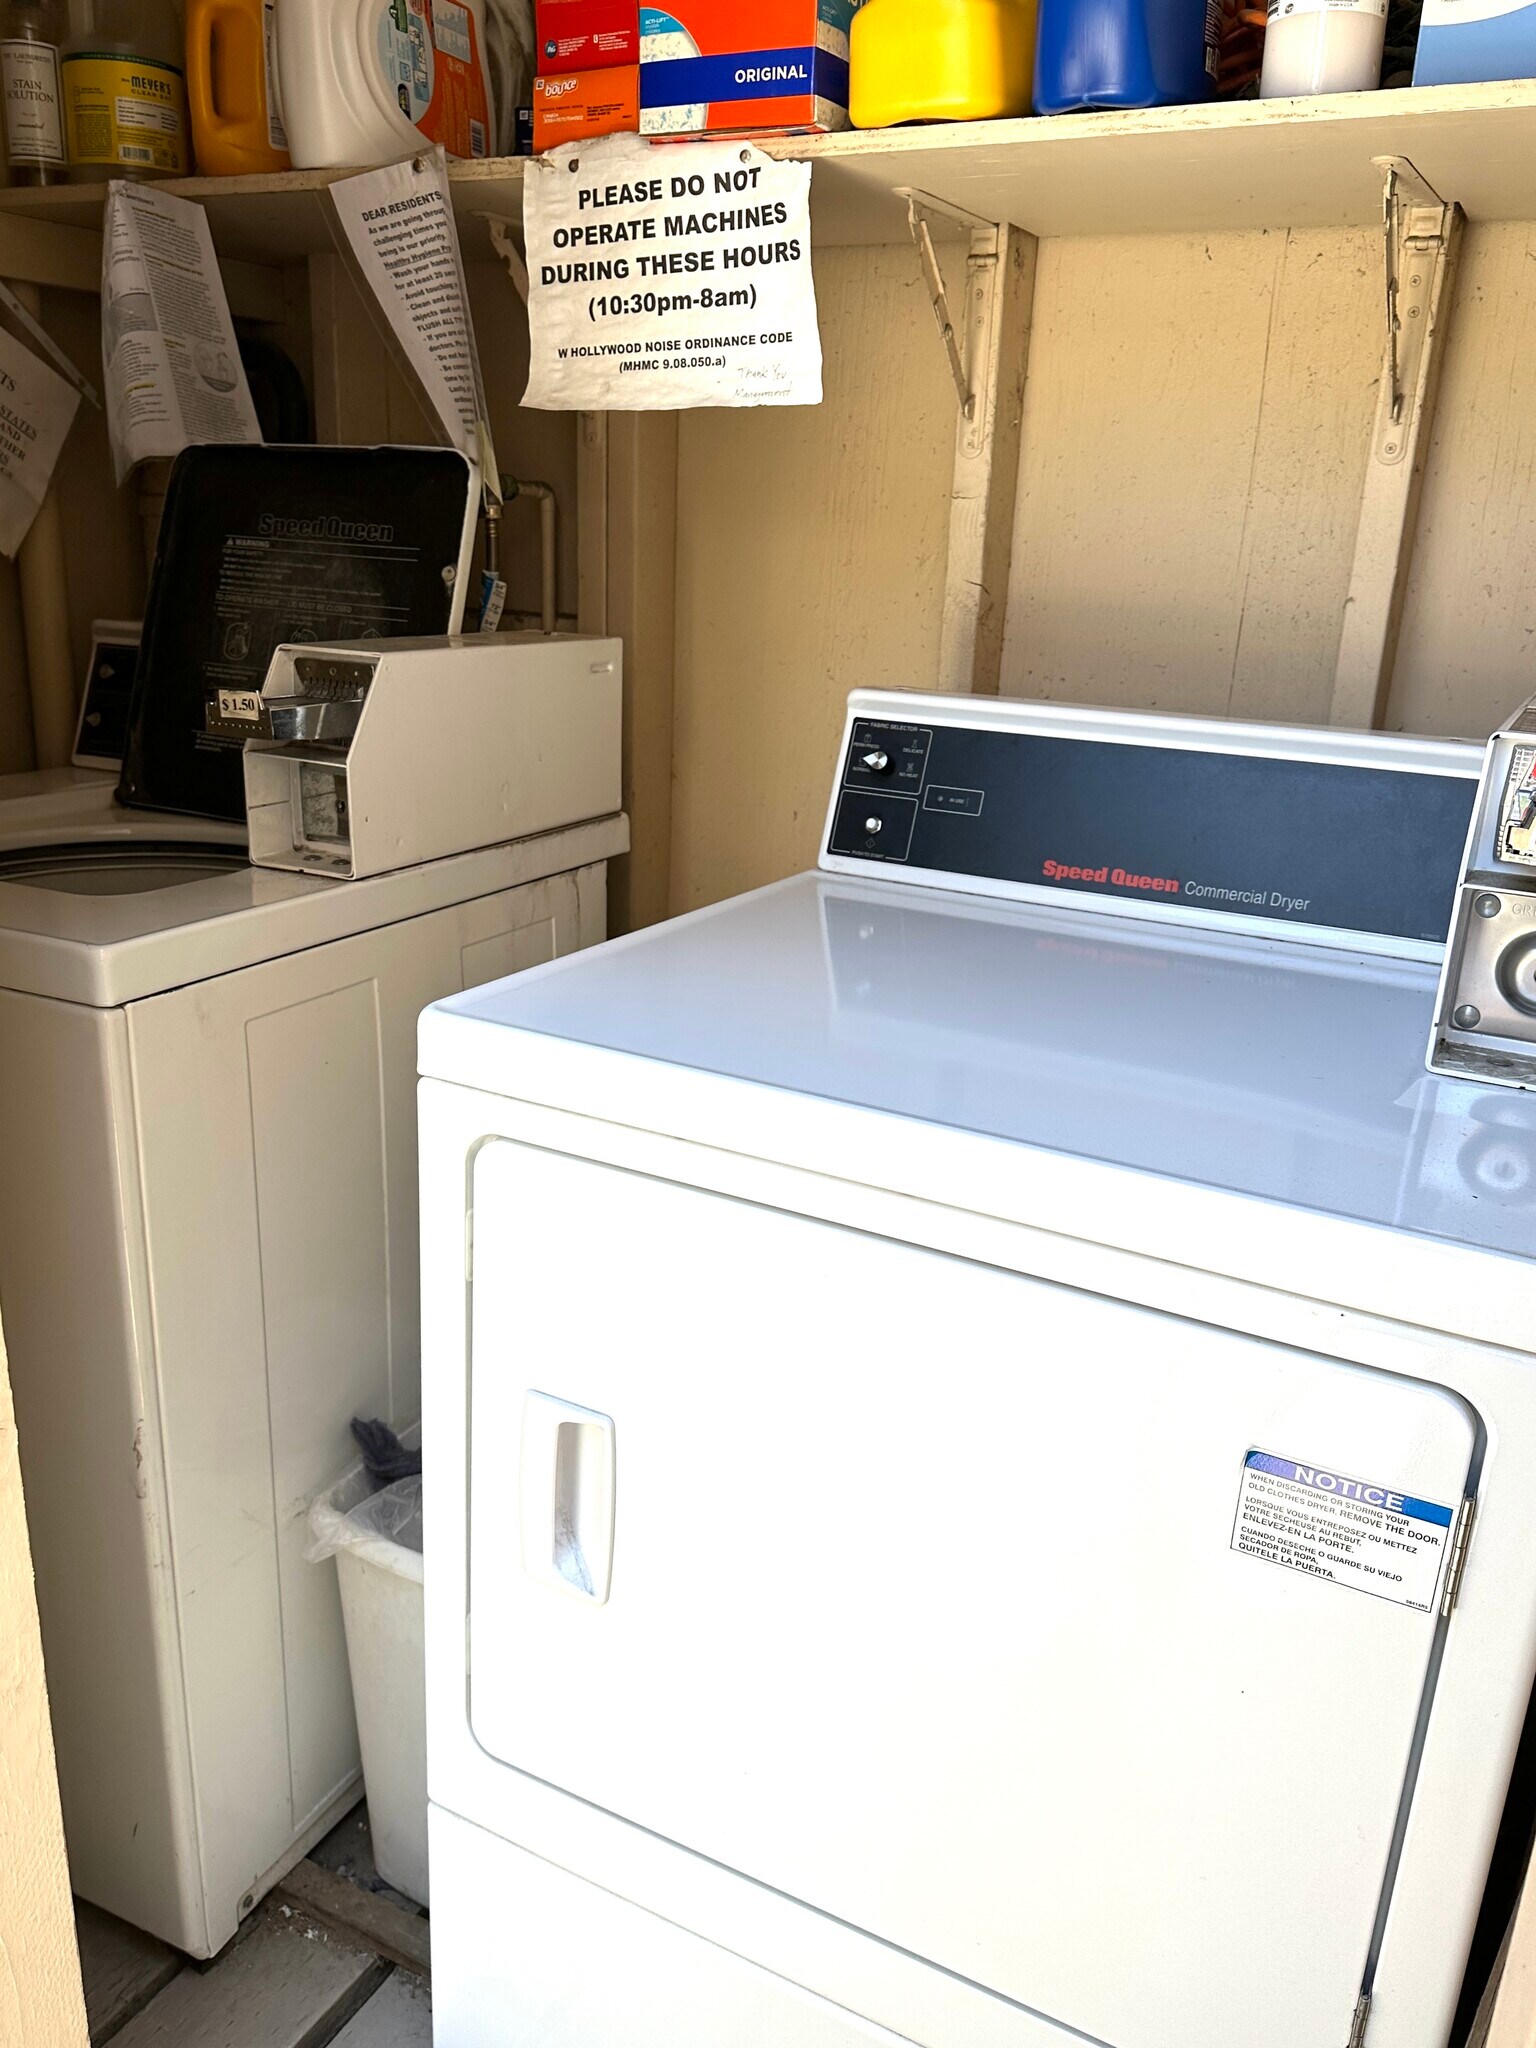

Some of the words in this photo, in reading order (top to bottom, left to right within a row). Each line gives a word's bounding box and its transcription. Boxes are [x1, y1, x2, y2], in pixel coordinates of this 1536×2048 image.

[12, 79, 42, 90] STAIN
[131, 75, 172, 95] MEYER'S
[734, 64, 808, 84] ORIGINAL
[6, 90, 54, 104] SOLUTION
[545, 79, 577, 97] bounce
[578, 179, 663, 211] PLEASE
[671, 175, 704, 198] DO
[714, 167, 761, 194] NOT
[361, 208, 390, 222] DEAR
[388, 190, 442, 214] RESIDENTS
[367, 227, 378, 236] As
[378, 224, 389, 232] we
[389, 220, 402, 229] are
[402, 214, 423, 227] going
[373, 231, 413, 246] challenging
[413, 224, 434, 234] times
[553, 218, 656, 249] OPERATE
[664, 201, 788, 237] MACHINES
[378, 246, 398, 258] being
[398, 244, 406, 252] is
[406, 242, 418, 250] our
[384, 256, 411, 269] Healthy
[411, 247, 441, 263] Hygiene
[392, 269, 413, 279] Wash
[413, 264, 430, 274] your
[541, 258, 629, 286] DURING
[636, 250, 716, 278] THESE
[723, 238, 801, 269] HOURS
[414, 274, 434, 286] least
[405, 290, 426, 300] Avoid
[410, 300, 431, 310] Clean
[588, 284, 757, 322] (10:30pm-8am)
[417, 321, 442, 332] FLUSH
[557, 348, 570, 359] W
[570, 342, 642, 357] HOLLYWOOD
[645, 339, 682, 353] NOISE
[685, 335, 756, 351] ORDINANCE
[760, 331, 793, 345] CODE
[618, 359, 659, 374] (MHMC
[662, 355, 726, 370] 9.08.050.a)
[0, 369, 17, 392] TS
[258, 513, 326, 538] Speed
[326, 515, 394, 543] Queen
[222, 698, 230, 712] $
[232, 698, 254, 712] 1.50
[870, 722, 890, 730] FABRIC
[890, 724, 918, 732] SELECTOR
[1042, 859, 1109, 883] Speed
[1111, 868, 1181, 894] Queen
[1184, 880, 1267, 905] Commercial
[1270, 892, 1311, 913] Dryer
[1250, 1472, 1275, 1486] WHEN
[1276, 1481, 1328, 1502] DISCARDING
[1330, 1497, 1343, 1506] OR
[1344, 1501, 1384, 1519] STORING
[1385, 1514, 1410, 1527] YOUR
[1294, 1465, 1405, 1512] NOTICE
[1244, 1503, 1271, 1518] VOTRE
[1272, 1512, 1318, 1532] SECHEUSE
[1318, 1528, 1331, 1536] AU
[1332, 1531, 1362, 1547] REBUT,
[1245, 1496, 1285, 1513] LORSQUE
[1286, 1508, 1310, 1521] VOUS
[1311, 1516, 1367, 1539] ENTREPOSEZ
[1368, 1534, 1382, 1543] OU
[1383, 1538, 1418, 1555] METTEZ
[1248, 1482, 1266, 1492] OLD
[1267, 1488, 1305, 1505] CLOTHES
[1340, 1510, 1383, 1529] REMOVE
[1385, 1522, 1406, 1536] THE
[1407, 1530, 1441, 1547] DOOR.
[1239, 1533, 1279, 1552] SECADOR
[1280, 1546, 1292, 1556] DE
[1242, 1512, 1302, 1537] ENLEVEZ-EN
[1303, 1531, 1316, 1542] LA
[1318, 1536, 1354, 1554] PORTE.
[1238, 1542, 1279, 1561] QUITELE
[1280, 1555, 1293, 1565] LA
[1295, 1560, 1336, 1580] PUERTA.
[1240, 1526, 1276, 1542] CUANDO
[1277, 1538, 1317, 1556] DESECHE
[1318, 1550, 1325, 1558] O
[1326, 1554, 1362, 1570] GUARDE
[1363, 1564, 1376, 1574] SU
[1377, 1568, 1403, 1582] VIEJO
